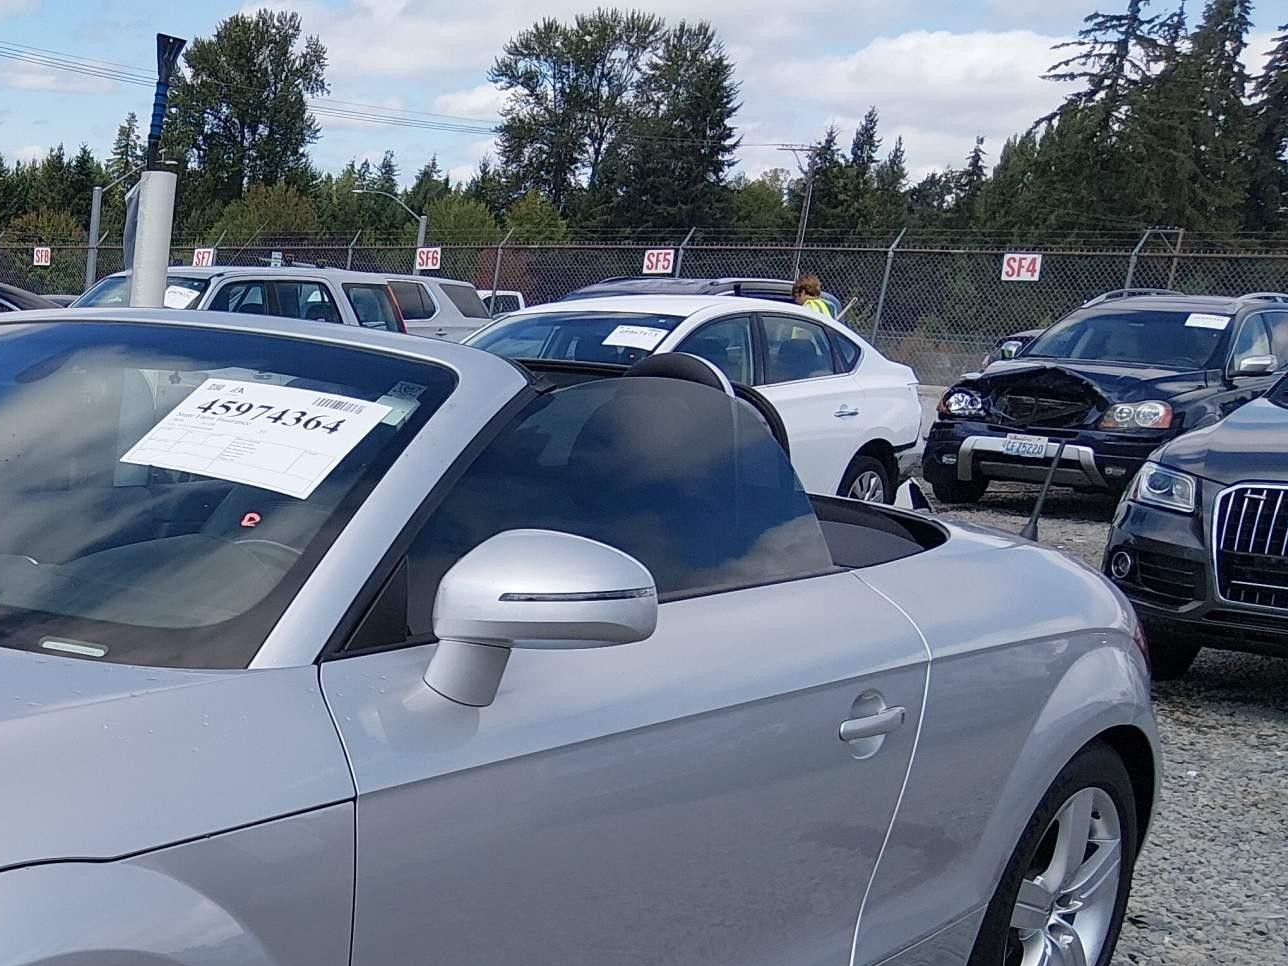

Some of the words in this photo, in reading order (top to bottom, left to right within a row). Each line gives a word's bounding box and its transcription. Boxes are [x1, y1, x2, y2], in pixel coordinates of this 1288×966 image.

[35, 248, 50, 264] SF8
[195, 250, 212, 266] SF7
[418, 250, 439, 267] SF6
[646, 252, 671, 271] SF5
[1005, 256, 1037, 277] SF4
[197, 398, 347, 435] 45974364
